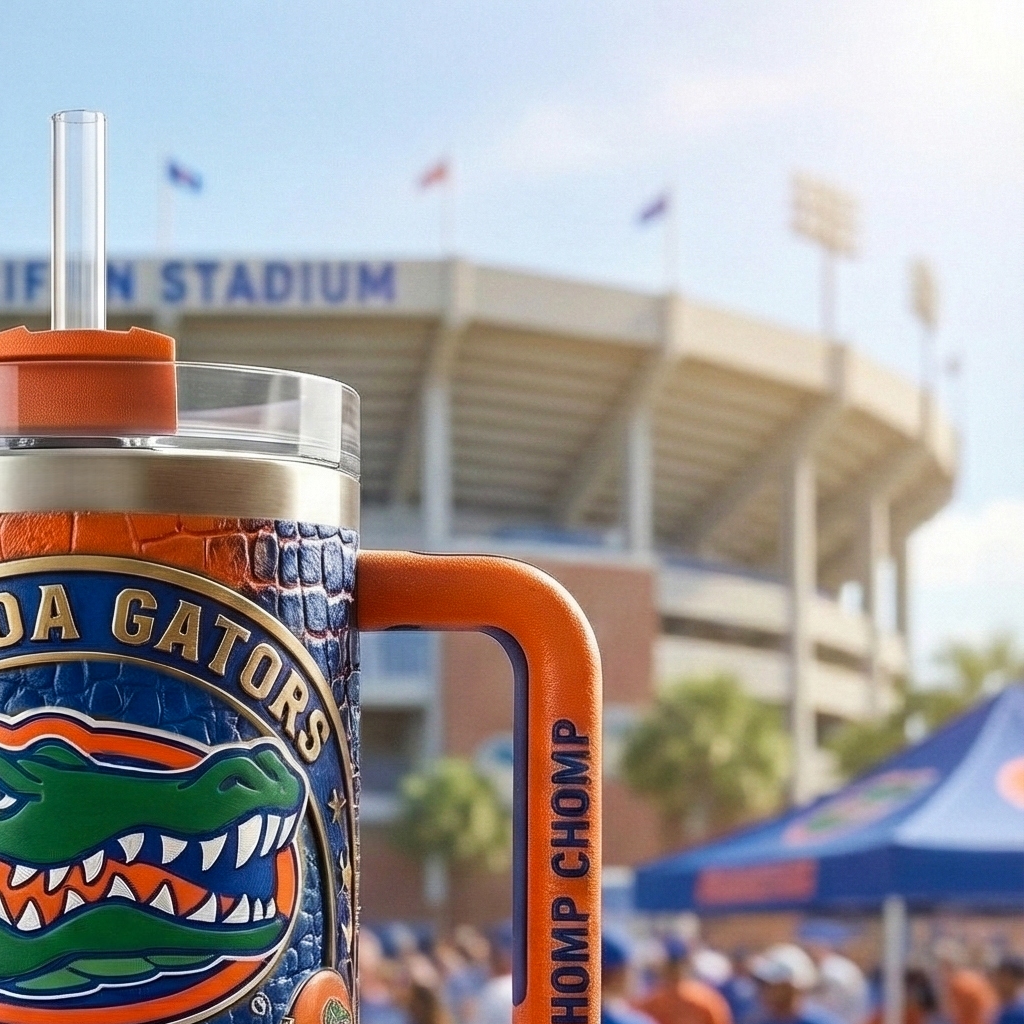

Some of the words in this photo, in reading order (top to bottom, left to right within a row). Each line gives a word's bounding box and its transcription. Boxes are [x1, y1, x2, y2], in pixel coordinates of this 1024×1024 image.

[161, 260, 395, 304] STADIUM
[111, 587, 331, 764] GATORS
[551, 718, 591, 879] CHOMP
